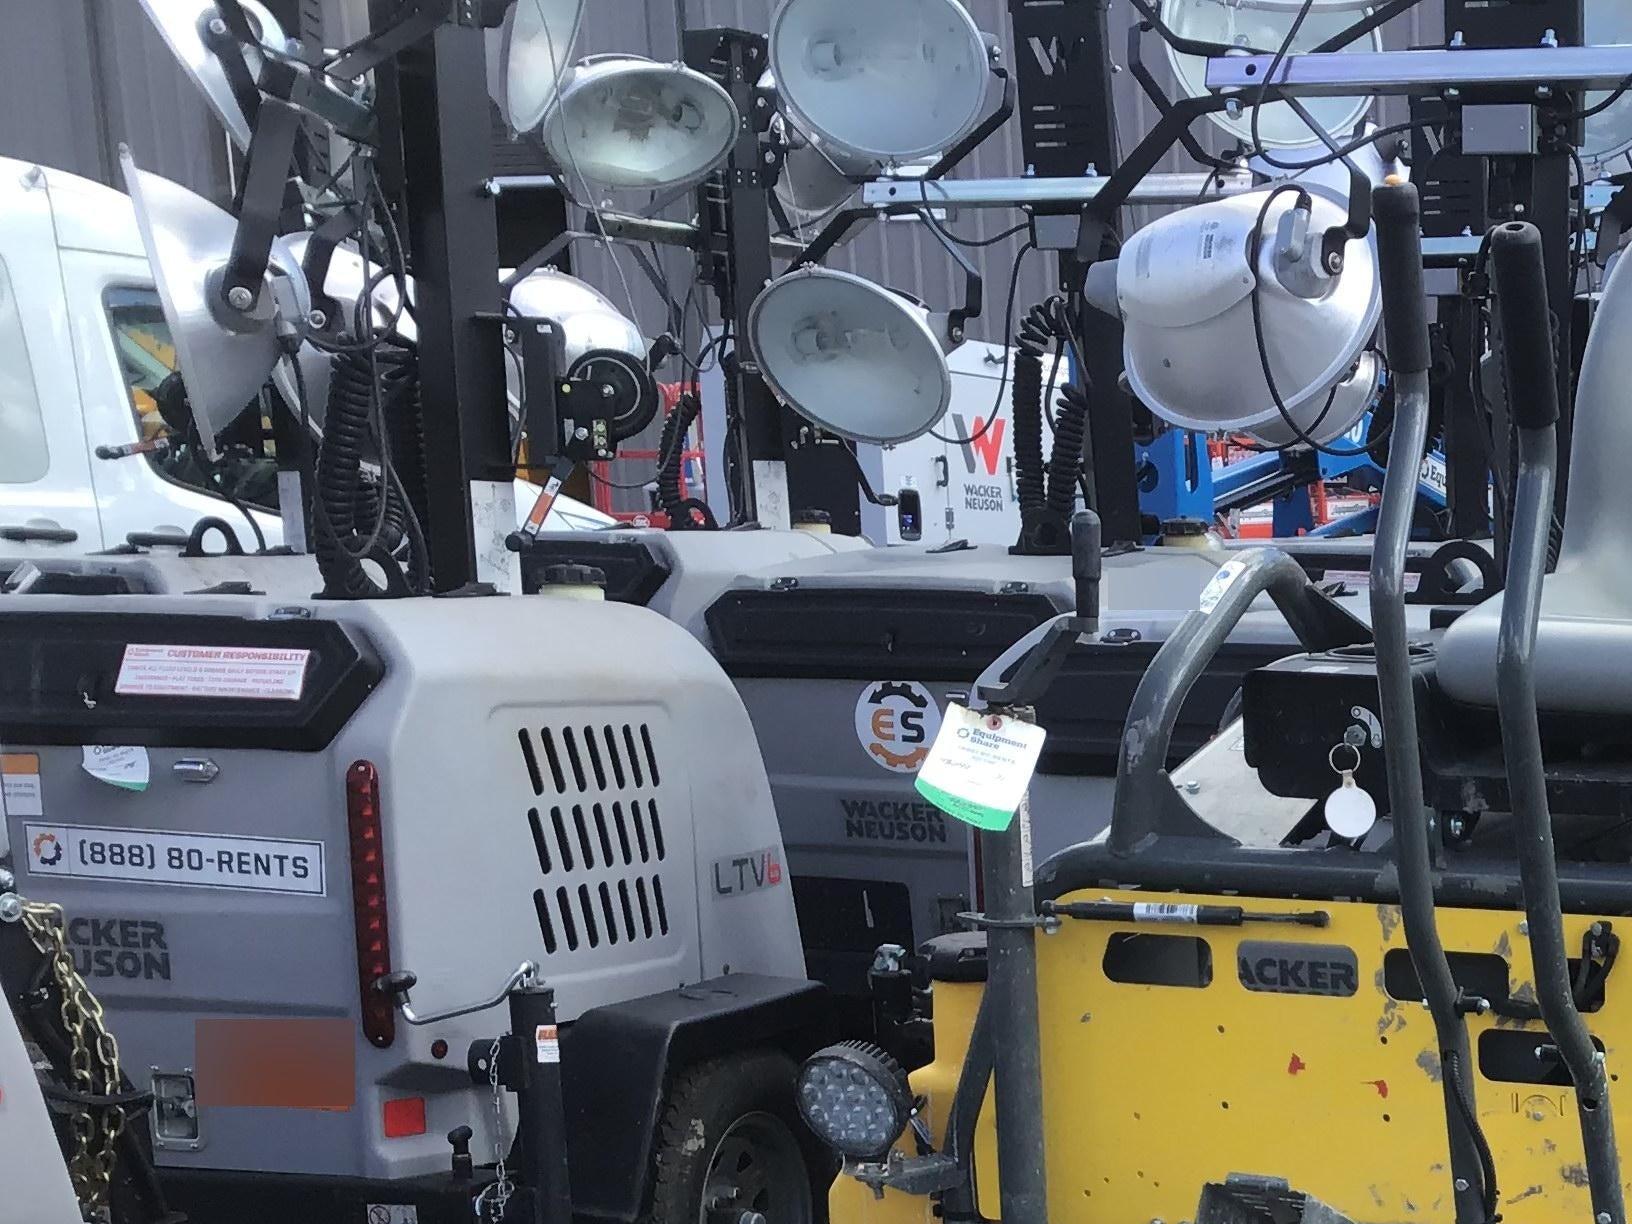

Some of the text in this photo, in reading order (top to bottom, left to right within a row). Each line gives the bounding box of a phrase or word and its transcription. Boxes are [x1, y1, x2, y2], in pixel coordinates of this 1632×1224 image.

[964, 484, 1002, 499] WACKER
[965, 498, 1003, 511] NEUSON
[167, 649, 223, 659] CUSTOMER
[223, 650, 306, 661] RESPONSIBILITY
[871, 708, 925, 743] ES
[970, 736, 1000, 750] Share
[972, 727, 1028, 749] Equipment
[840, 799, 945, 824] WACKER
[846, 819, 947, 842] NEUSON
[79, 839, 309, 879] (888) 80-RENTS
[714, 852, 782, 894] LTV6
[65, 917, 168, 950] CKER
